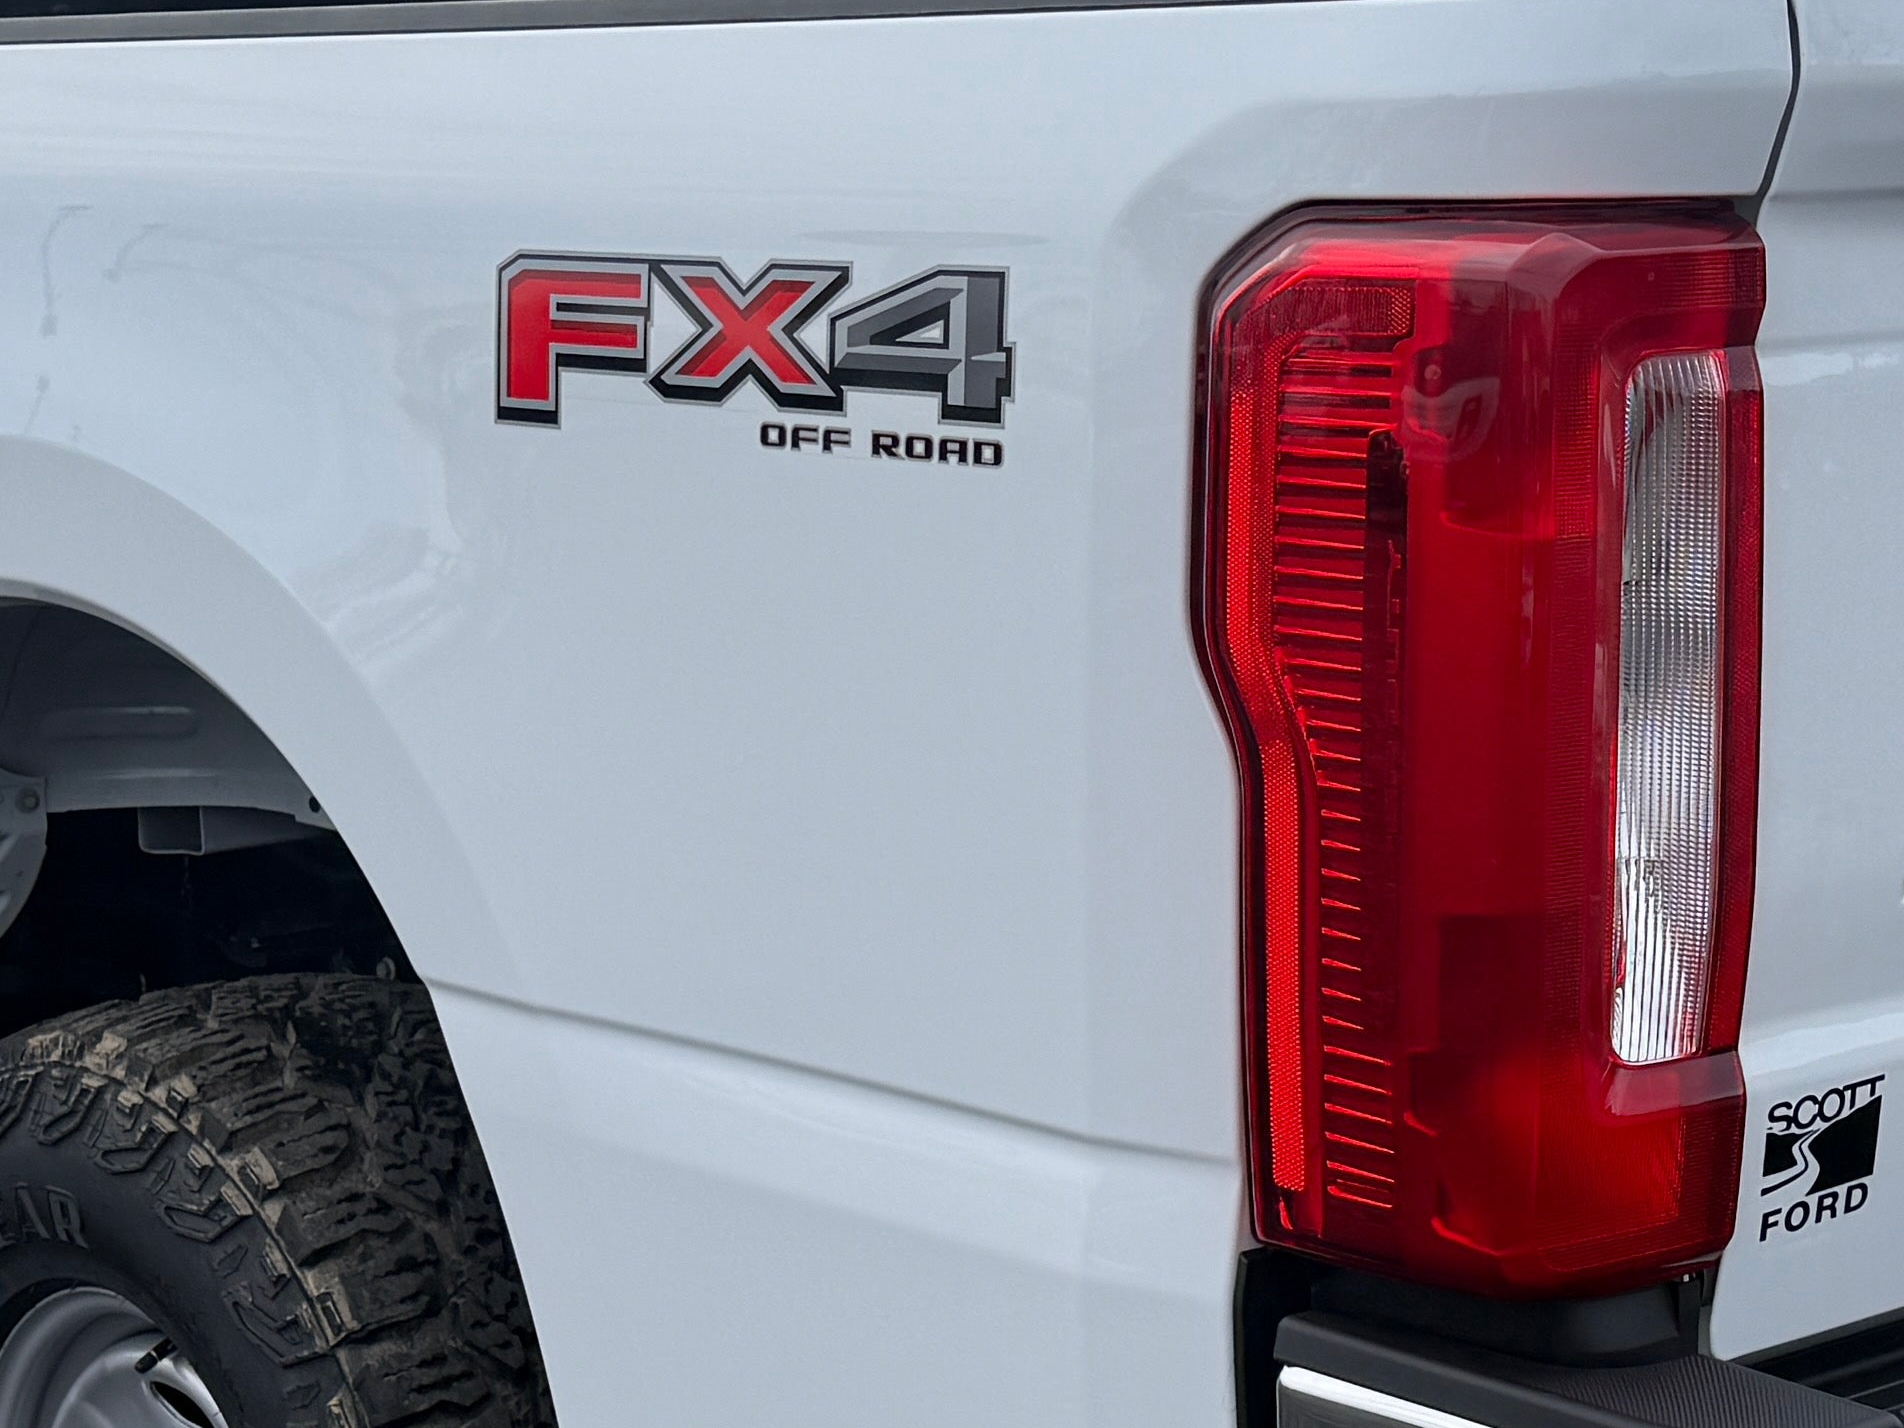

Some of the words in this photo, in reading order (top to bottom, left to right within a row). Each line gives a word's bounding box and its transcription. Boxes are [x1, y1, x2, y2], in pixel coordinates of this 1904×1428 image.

[495, 249, 1017, 429] FX4
[759, 420, 852, 454] OFF
[870, 429, 1006, 469] ROAD
[1766, 1074, 1885, 1132] SCOTT
[1759, 1182, 1869, 1242] FORD
